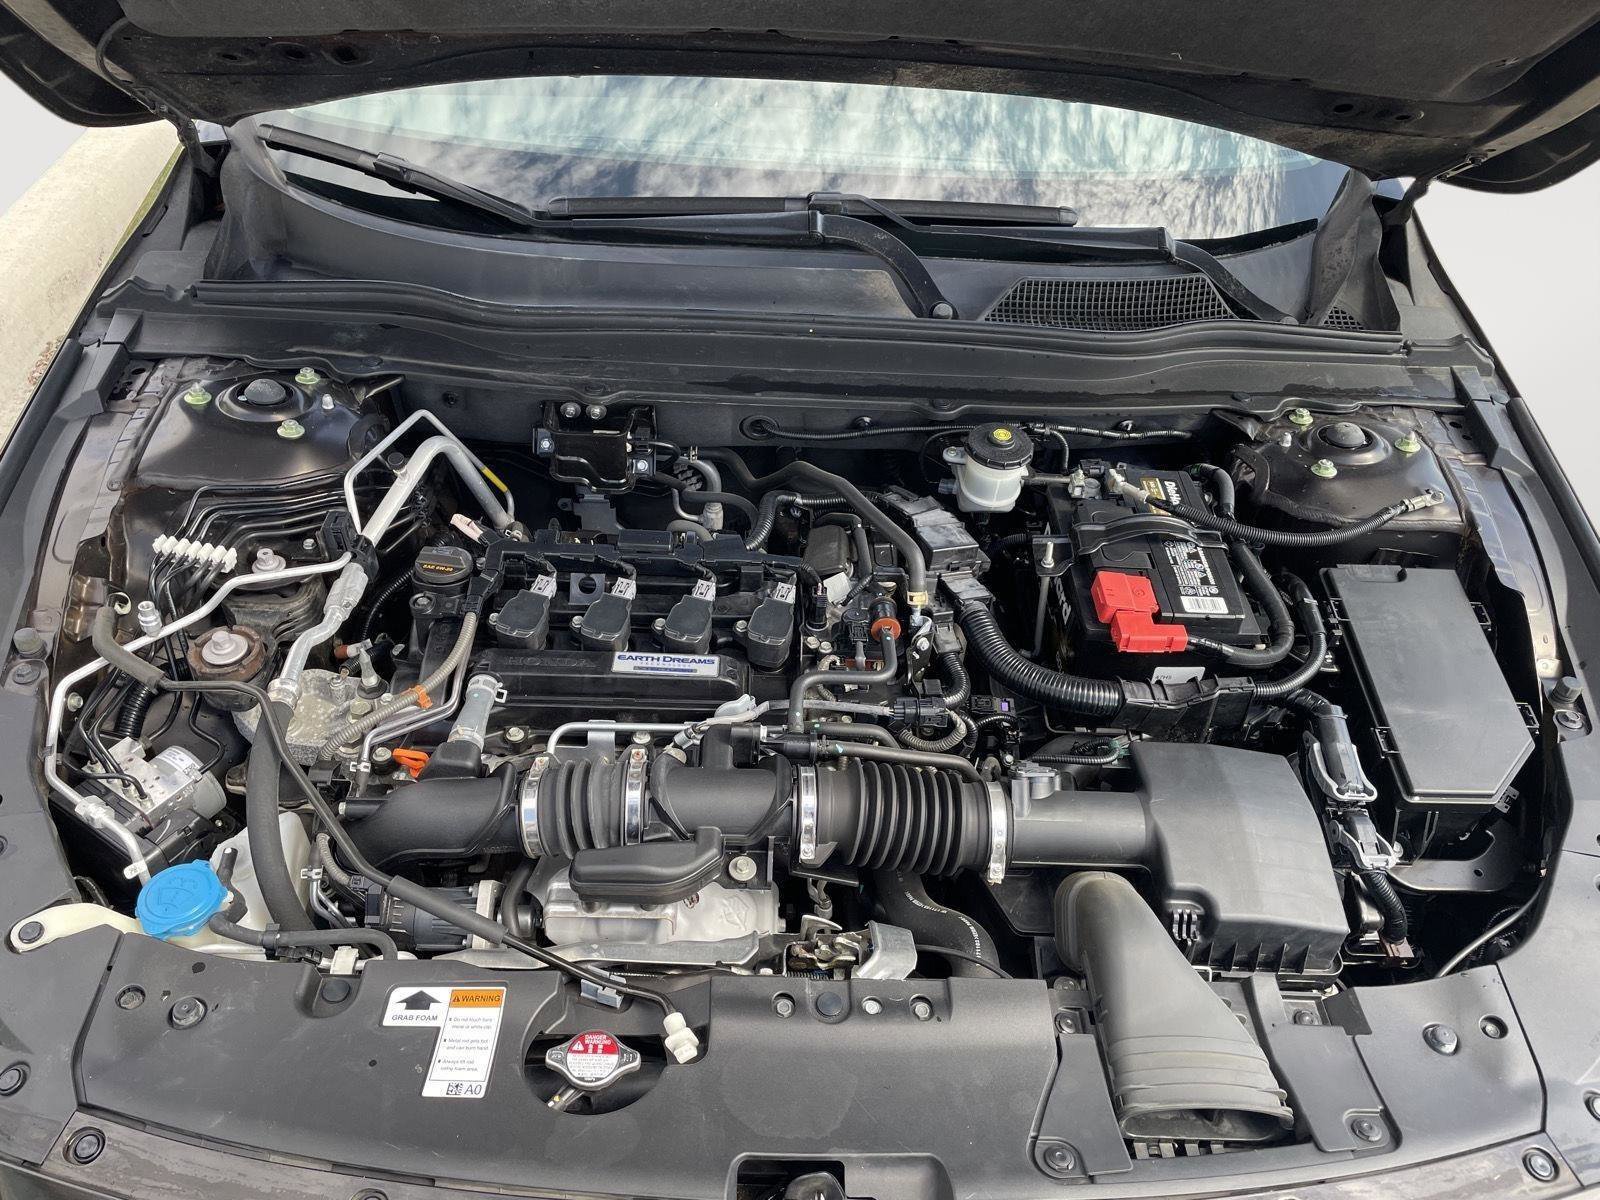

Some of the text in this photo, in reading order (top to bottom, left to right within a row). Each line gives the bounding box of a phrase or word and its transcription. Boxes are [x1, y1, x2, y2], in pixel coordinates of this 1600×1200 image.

[1164, 480, 1181, 505] DieHa
[504, 656, 600, 668] HONDA
[662, 656, 715, 664] DREAMS
[461, 994, 501, 1002] WARNING
